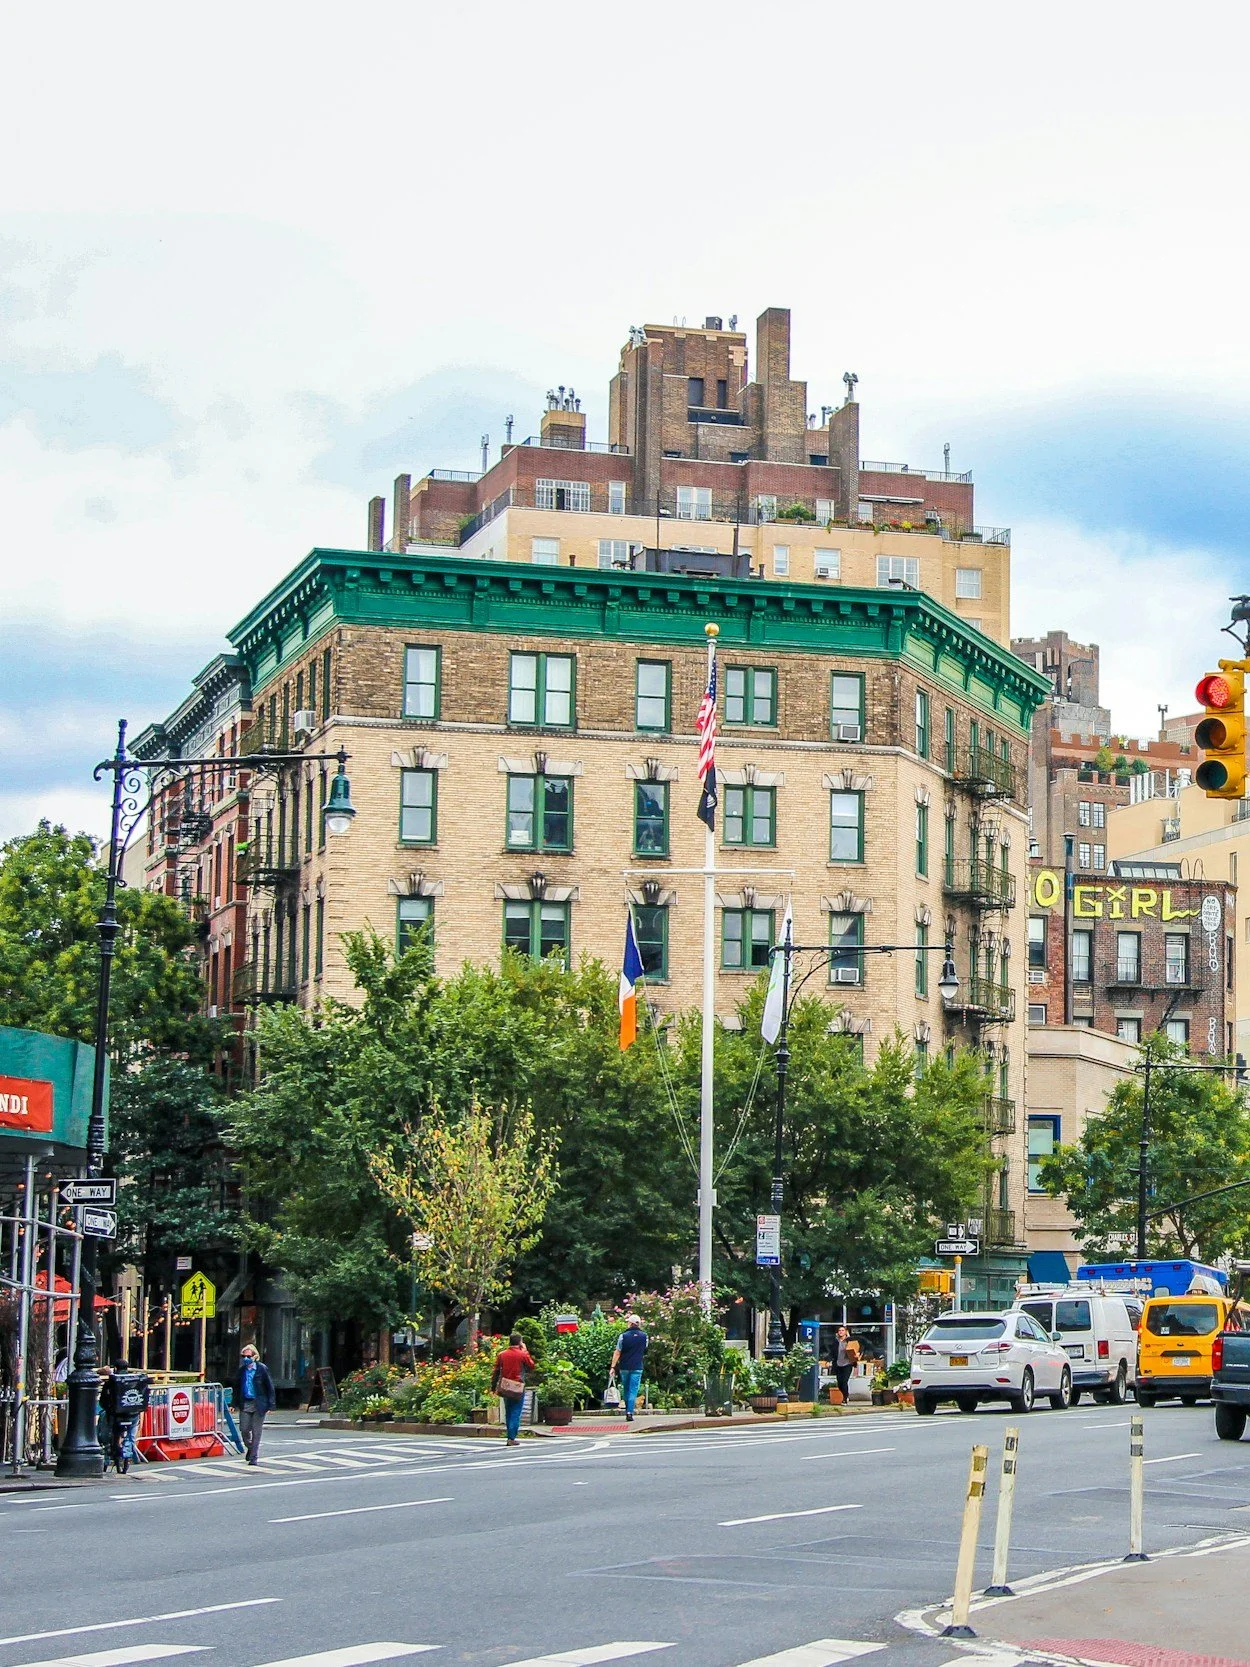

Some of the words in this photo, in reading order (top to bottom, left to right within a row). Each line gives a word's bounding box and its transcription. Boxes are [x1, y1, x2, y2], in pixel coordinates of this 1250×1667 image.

[66, 1187, 83, 1198] ONE
[90, 1187, 107, 1197] WAY
[806, 1327, 813, 1337] P
[180, 1397, 188, 1405] NOT
